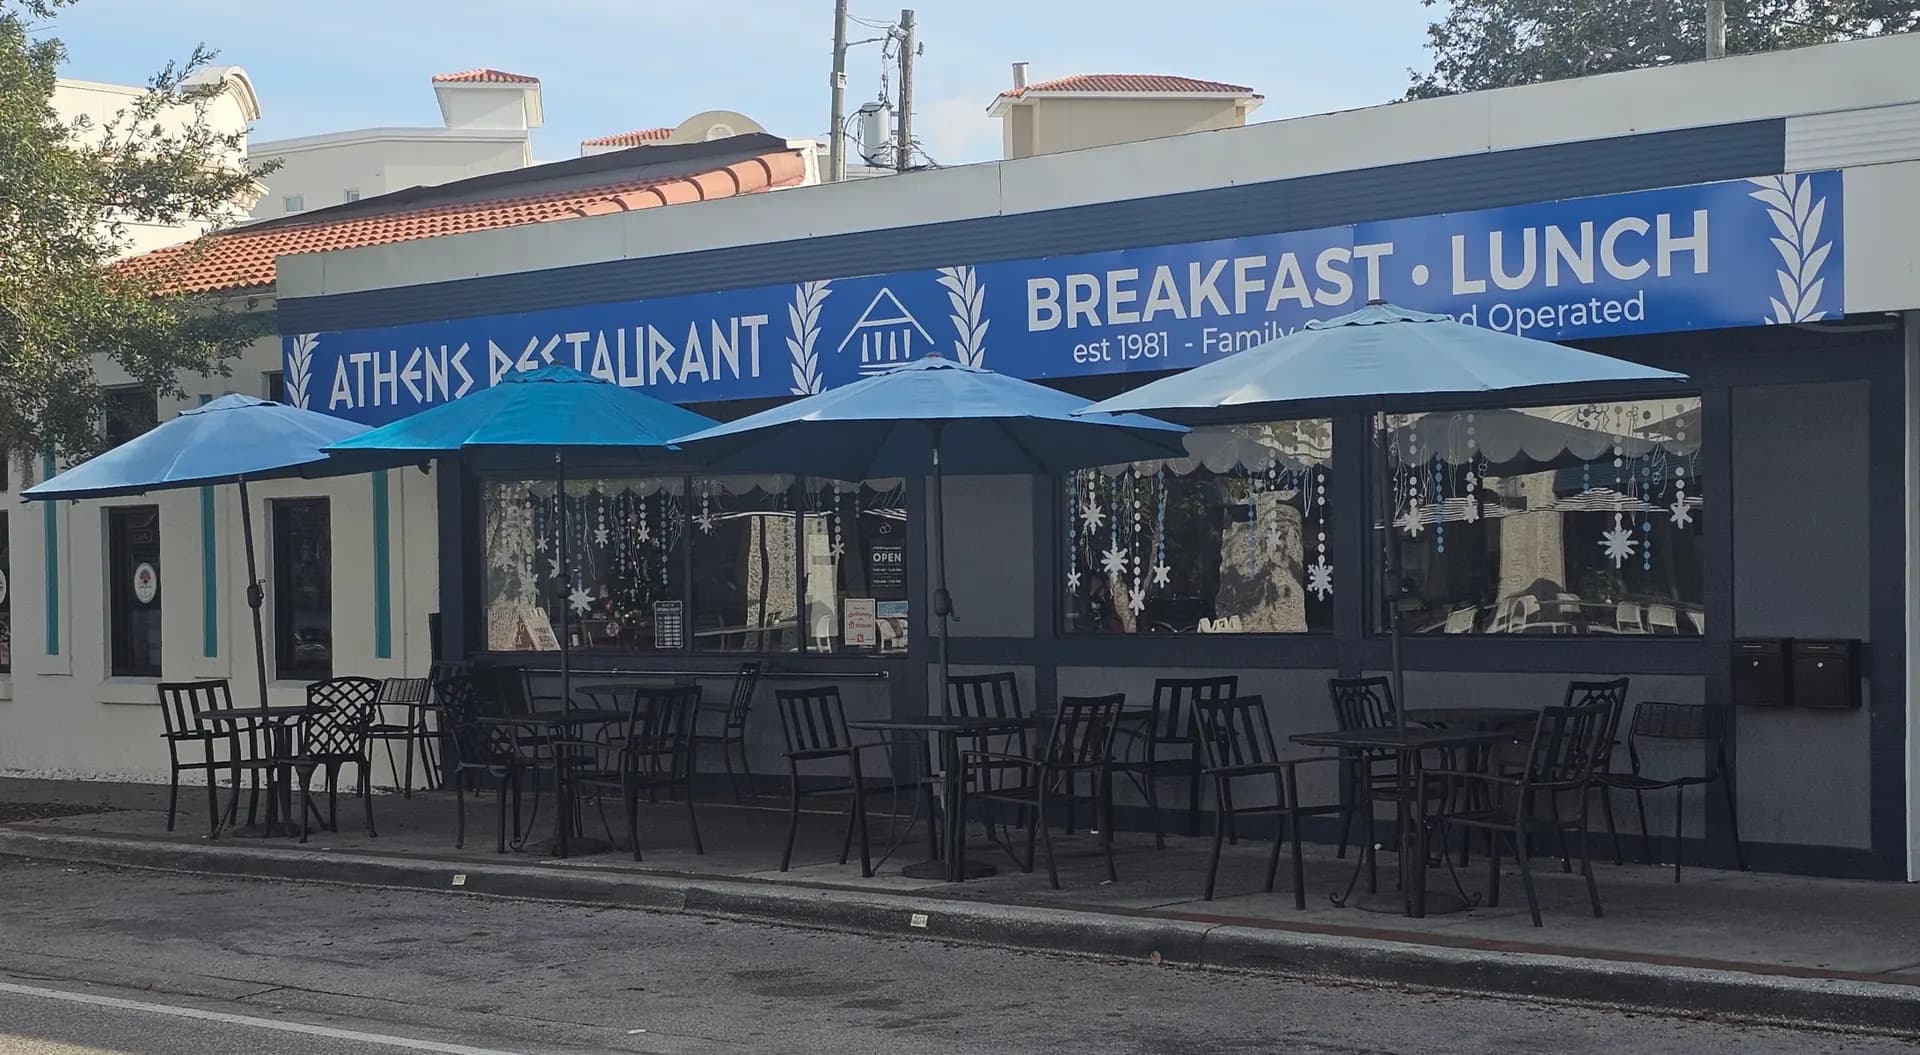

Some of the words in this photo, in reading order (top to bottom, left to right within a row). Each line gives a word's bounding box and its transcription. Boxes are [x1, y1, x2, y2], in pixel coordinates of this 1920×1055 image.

[1027, 242, 1394, 332] BREAKFAST
[1451, 209, 1709, 296] LUNCH
[1073, 338, 1111, 363] est
[1117, 331, 1169, 360] 1981
[1488, 289, 1645, 337] Operated
[329, 342, 475, 410] ATHENS
[873, 553, 901, 562] OPEN
